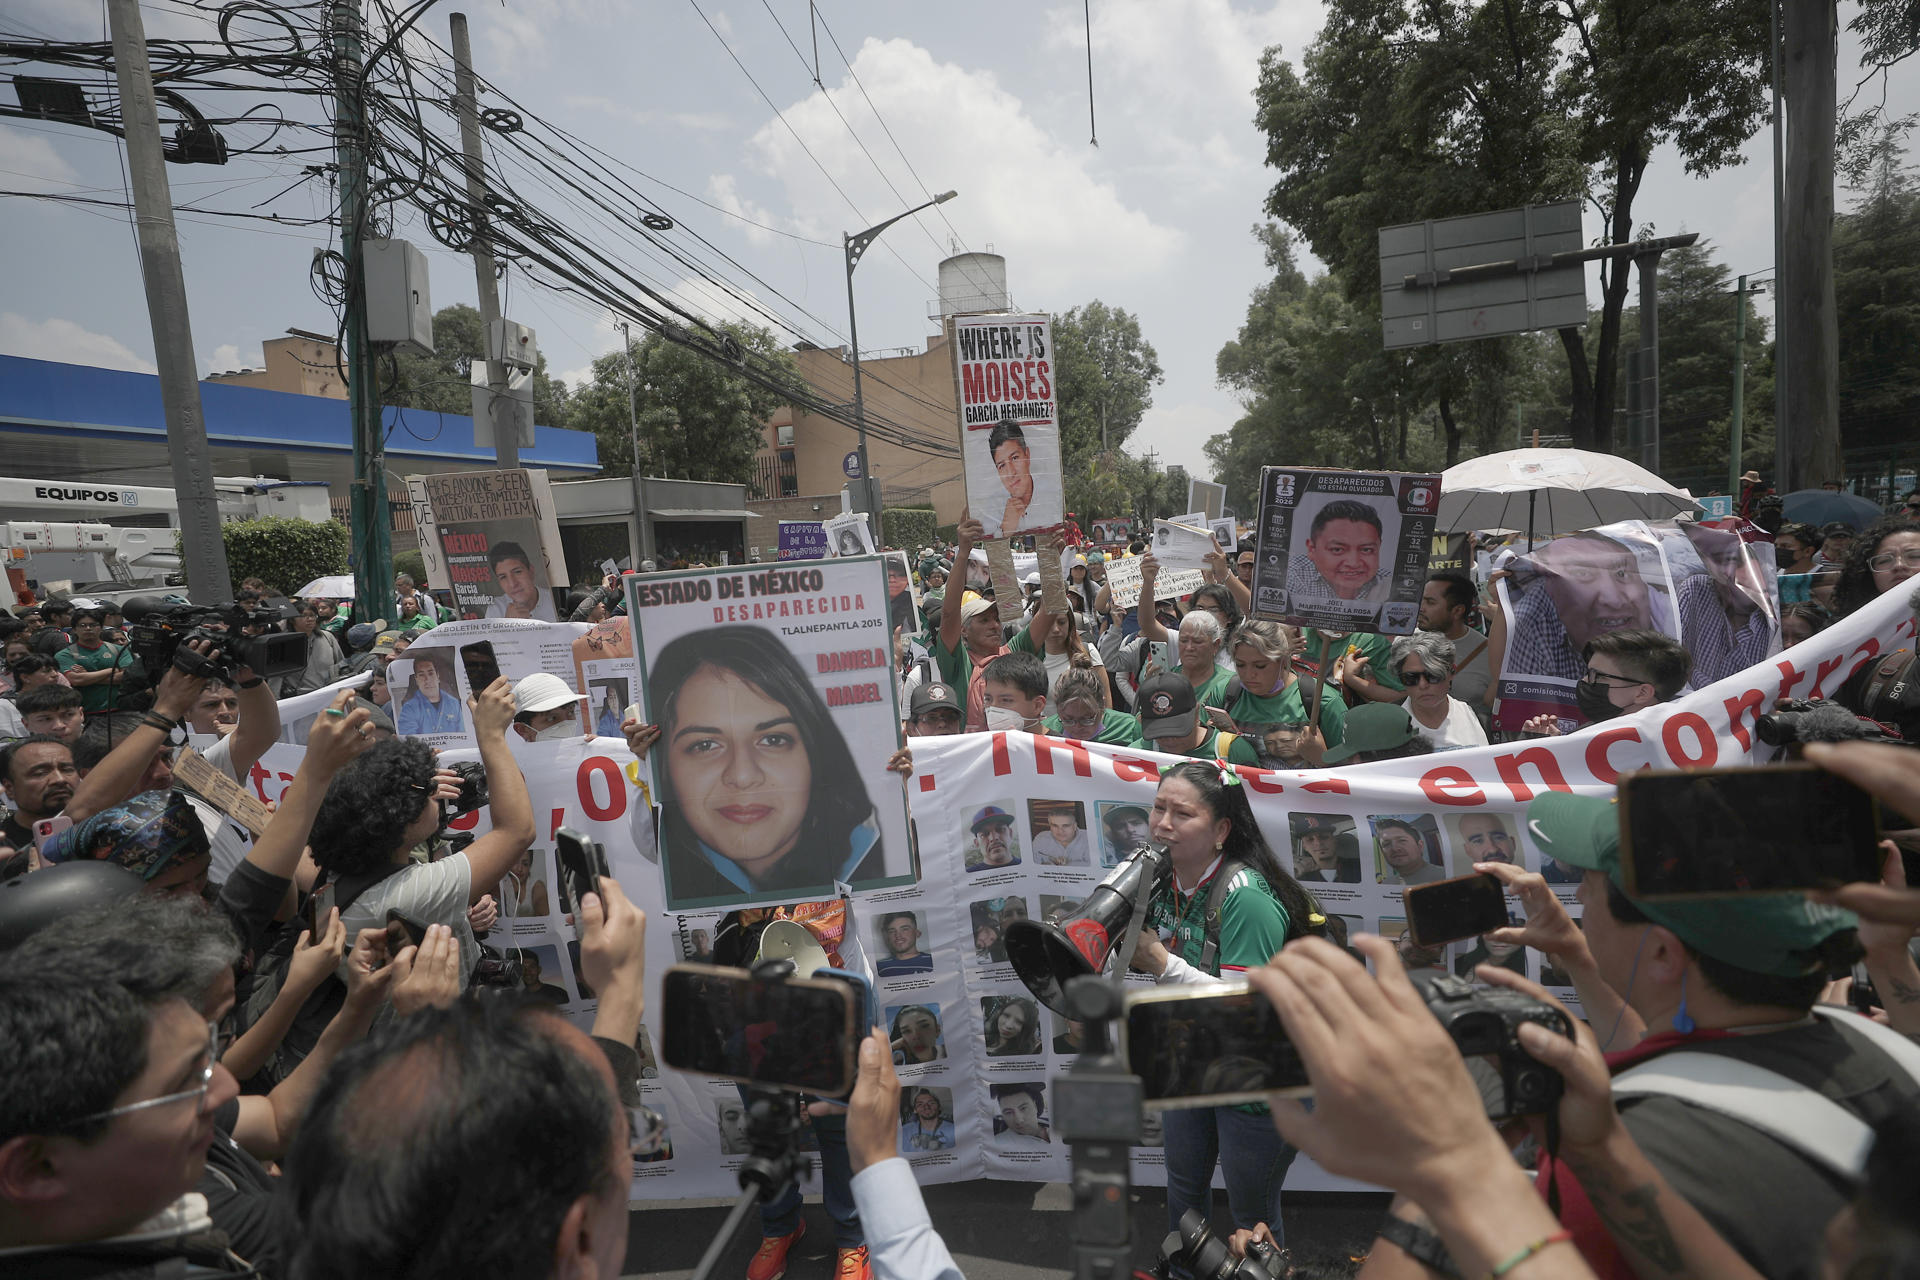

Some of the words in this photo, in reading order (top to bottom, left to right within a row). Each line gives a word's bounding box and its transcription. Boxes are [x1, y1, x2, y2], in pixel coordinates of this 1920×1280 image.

[958, 326, 1023, 361] WHERE
[1027, 326, 1045, 359] IS
[962, 354, 1051, 404] MOISÉS
[966, 403, 999, 423] GARCÍA
[494, 472, 530, 491] SEEN
[1318, 476, 1385, 487] DESAPARECIDOS
[1349, 485, 1384, 493] OLVIDADOS
[35, 487, 119, 503] EQUIPOS
[480, 503, 501, 520] FOR
[502, 499, 531, 517] HIM
[443, 530, 489, 555] MÉXICO
[1430, 535, 1448, 556] N
[1427, 559, 1463, 570] ARTE
[454, 582, 479, 595] García
[637, 580, 712, 608] ESTADO
[717, 575, 745, 600] DE
[749, 568, 824, 598] MÉXICO
[457, 593, 495, 605] Hernández
[712, 593, 865, 624] DESAPARECIDA
[444, 623, 480, 633] BOLETÍN
[781, 620, 860, 636] TLALNEPANTLA
[861, 618, 883, 629] 2015
[815, 647, 887, 674] DANIELA
[825, 682, 882, 708] MABEL
